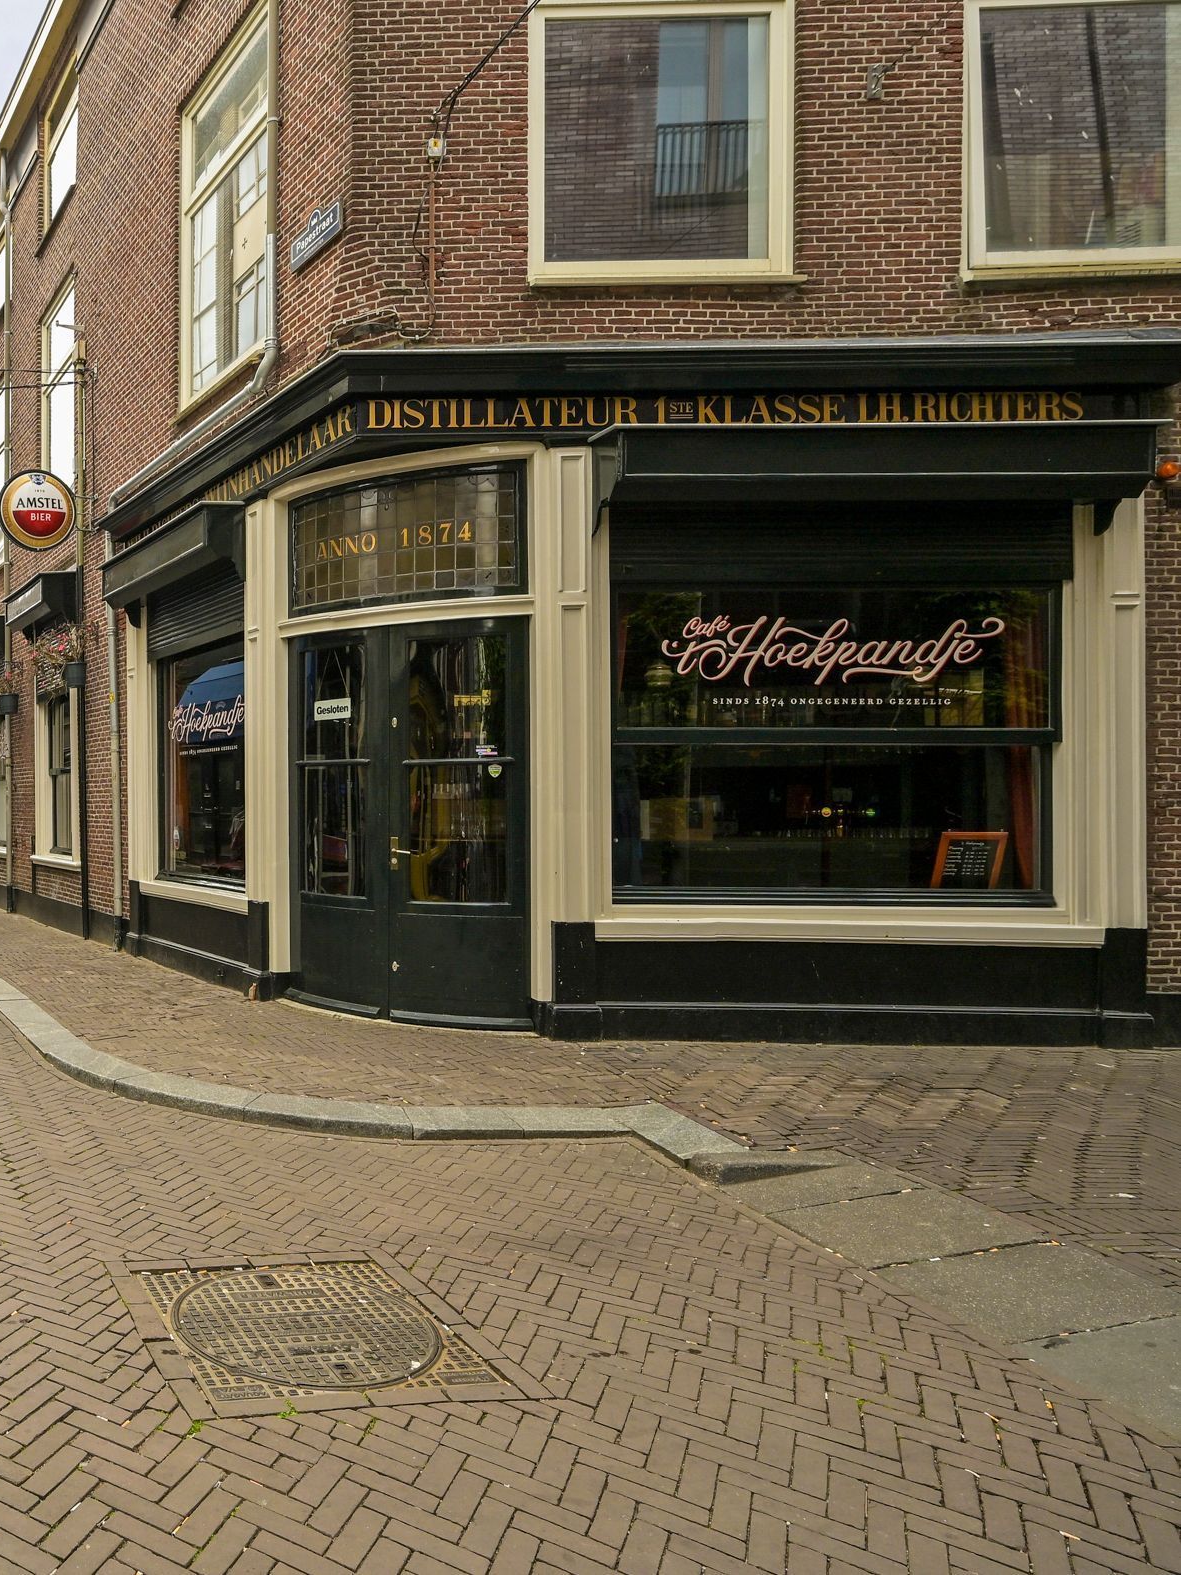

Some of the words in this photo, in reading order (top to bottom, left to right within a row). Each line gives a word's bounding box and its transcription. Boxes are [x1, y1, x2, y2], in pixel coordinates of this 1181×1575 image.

[296, 212, 334, 254] Papestraat
[366, 396, 639, 429] DISTILLATEUR
[697, 395, 846, 424] KLASSE
[16, 497, 63, 510] AMSTEL
[30, 512, 52, 522] BIER
[317, 532, 376, 561] ANNO
[400, 521, 472, 547] 1874
[682, 614, 732, 640] Café
[699, 615, 1006, 687] Hoekpandje
[316, 704, 349, 715] Gesloten
[712, 697, 750, 706] SINDS
[754, 696, 786, 709] 1874
[790, 697, 884, 706] ONGEGENEERD
[889, 697, 952, 706] GEZELLIG
[176, 694, 246, 744] Hoekpandje
